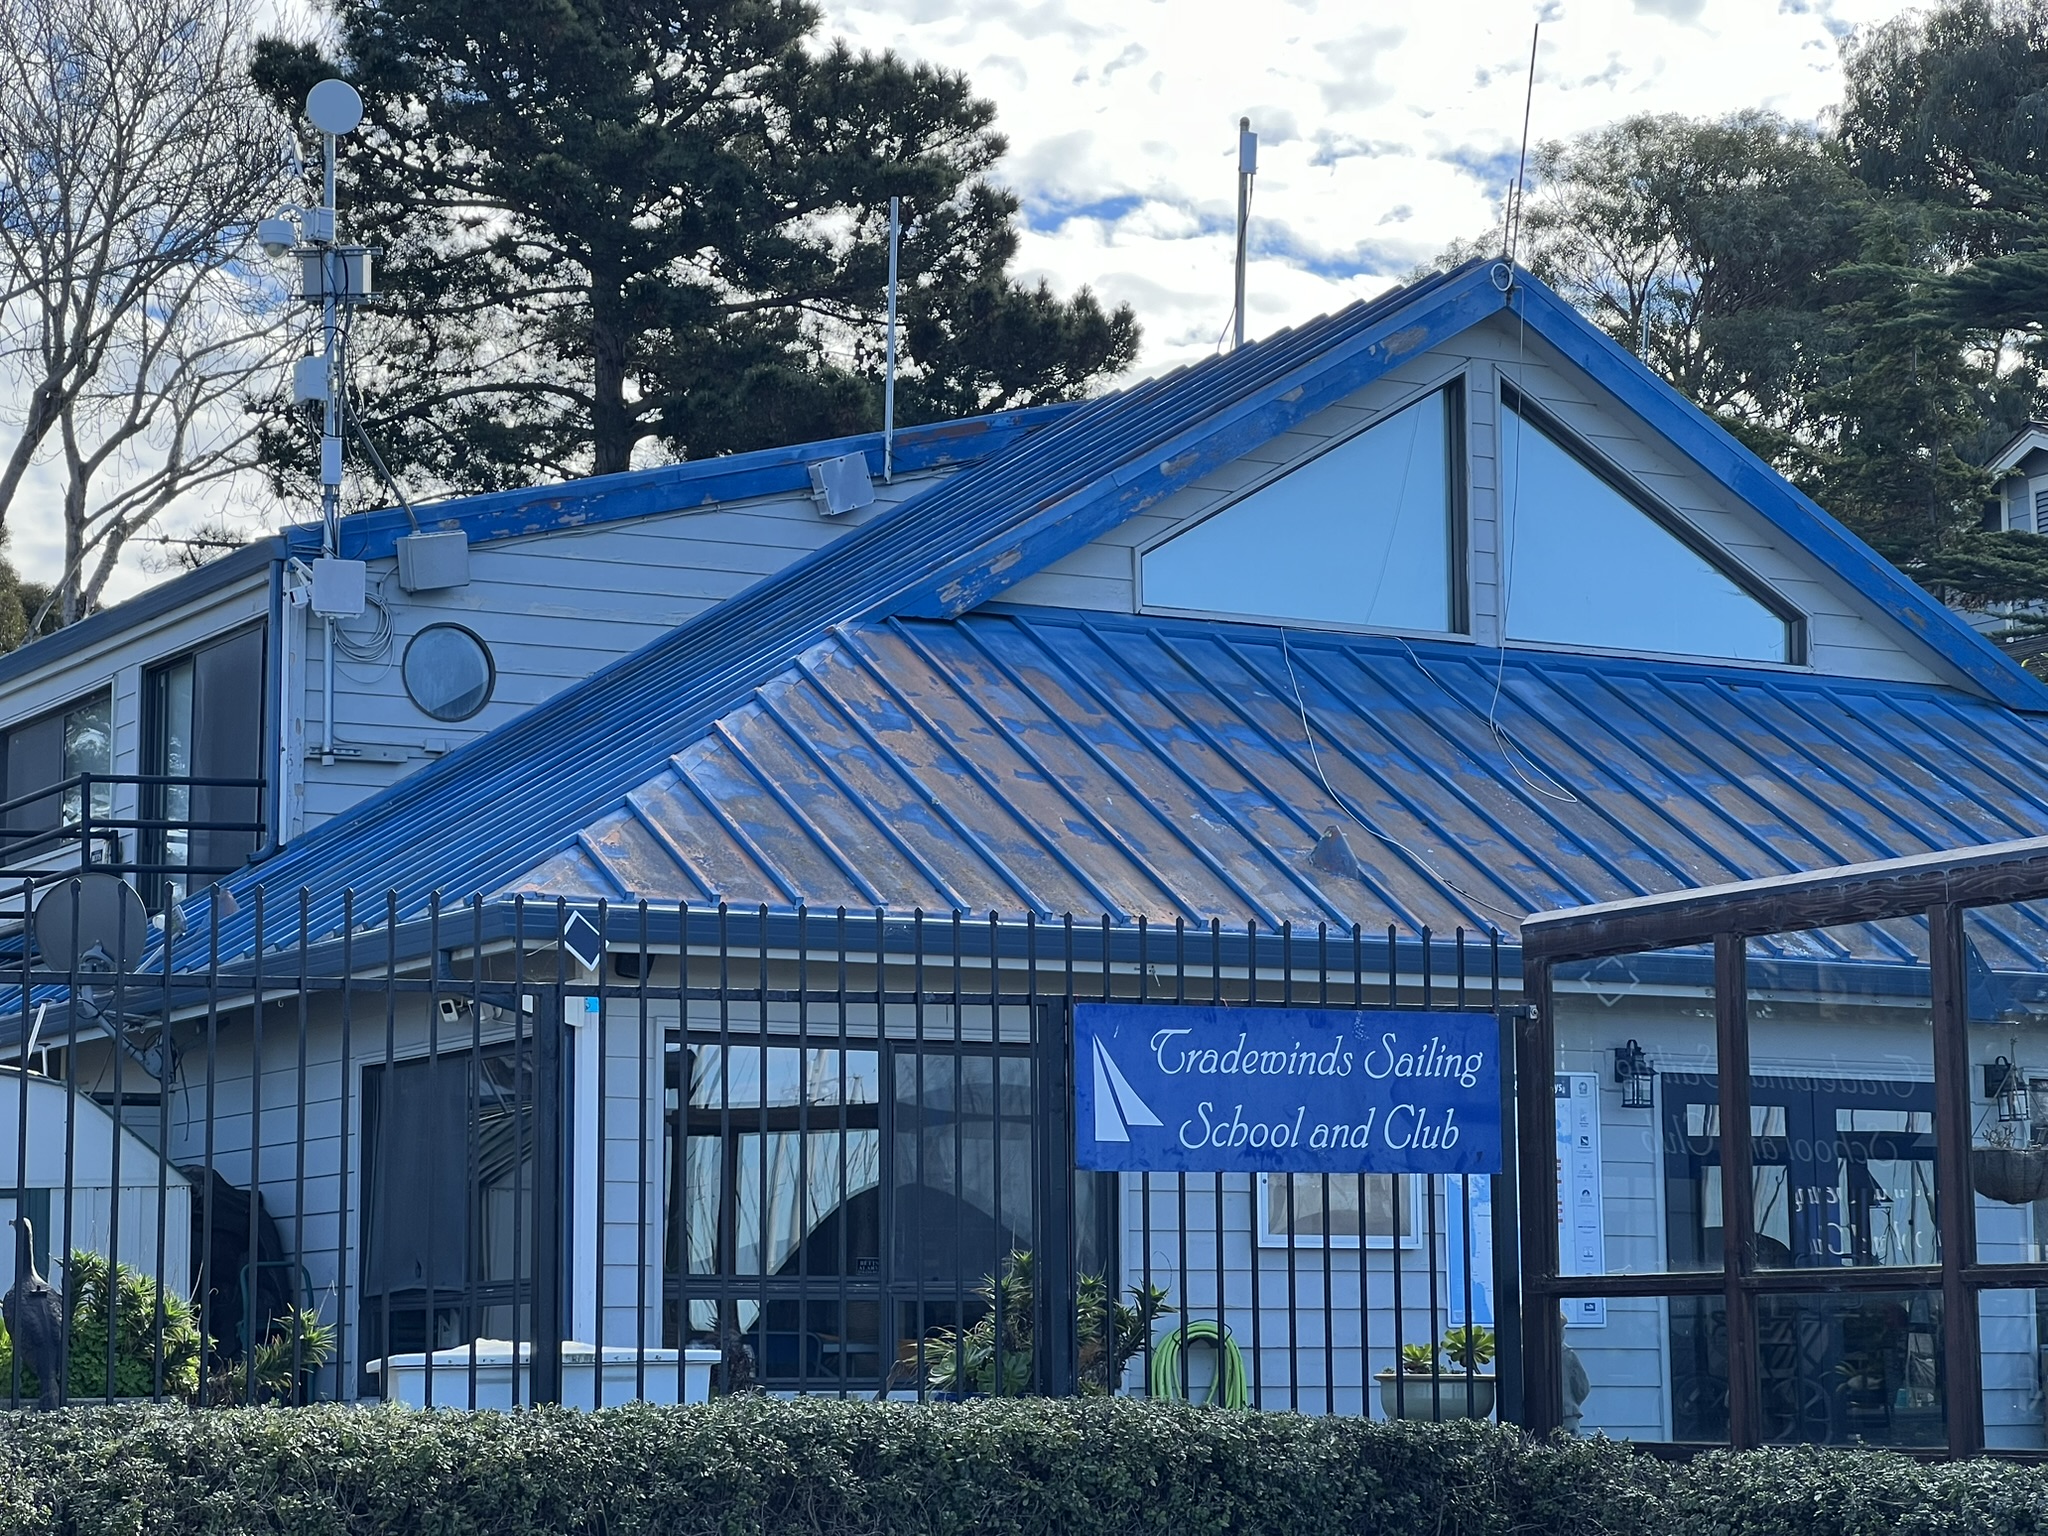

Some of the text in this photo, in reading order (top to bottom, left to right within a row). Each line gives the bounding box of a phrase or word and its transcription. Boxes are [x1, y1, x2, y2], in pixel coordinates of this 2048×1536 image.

[1150, 1028, 1483, 1088] Tradewinds Sailing
[1178, 1101, 1460, 1151] School and Club
